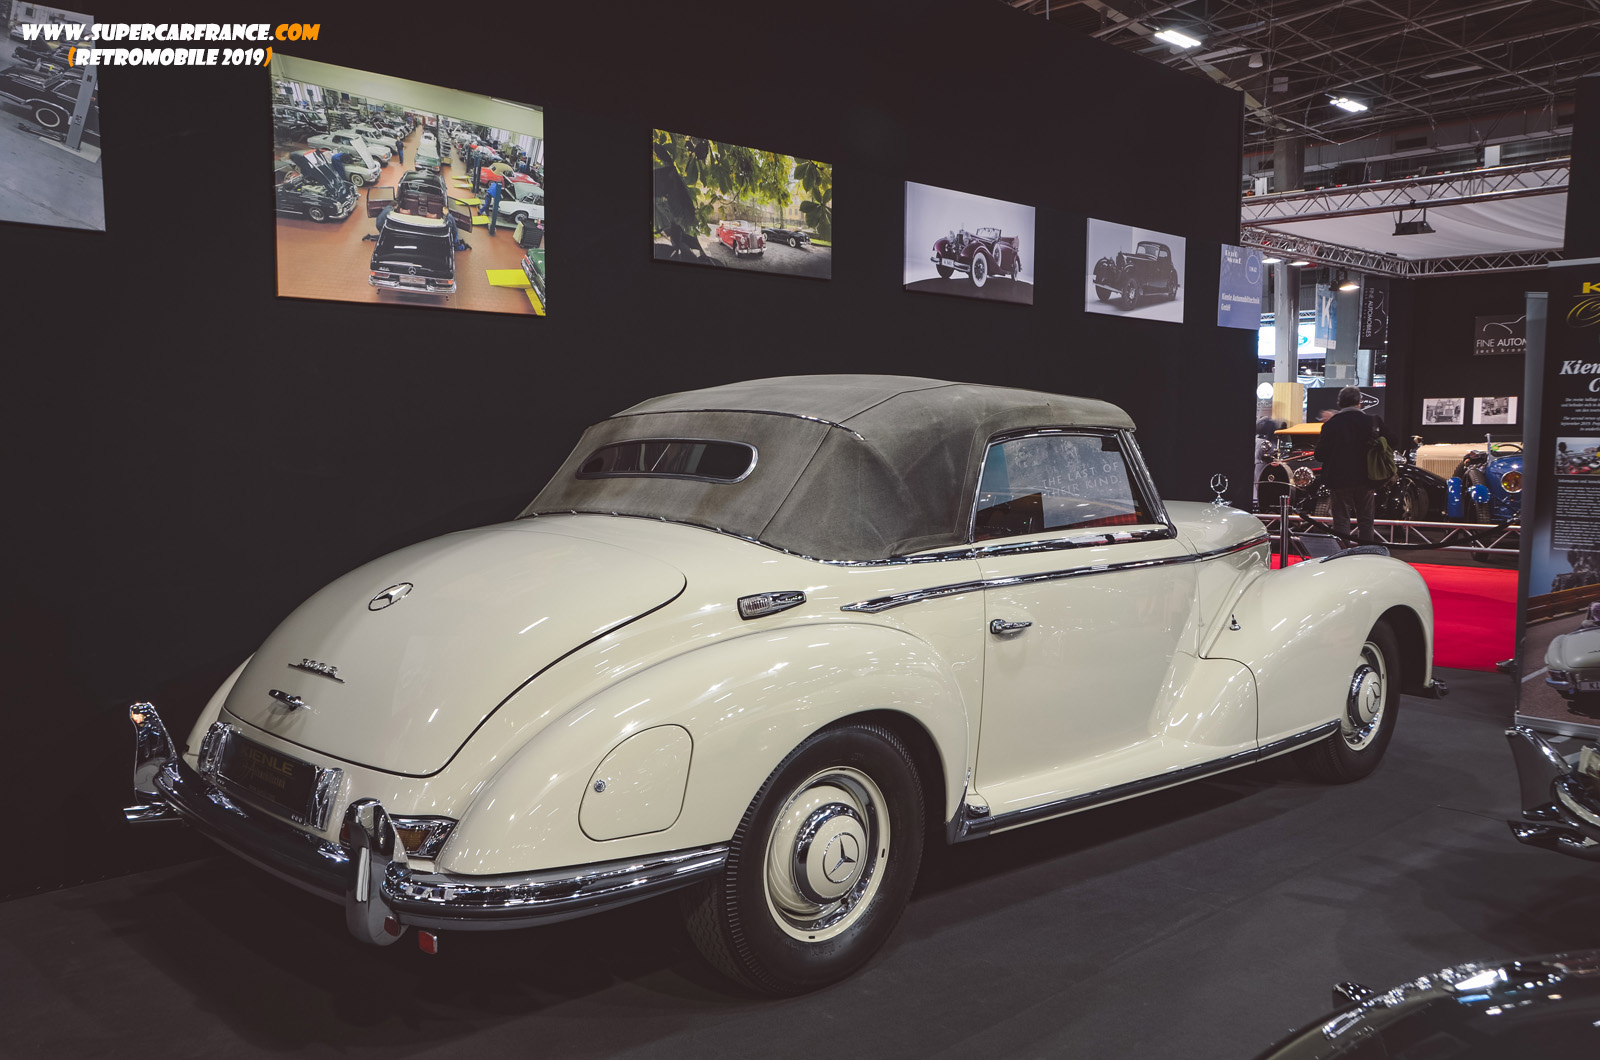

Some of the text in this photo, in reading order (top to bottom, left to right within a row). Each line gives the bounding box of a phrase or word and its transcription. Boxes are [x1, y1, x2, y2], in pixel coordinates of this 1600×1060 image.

[1476, 339, 1495, 348] FINE
[1042, 463, 1119, 489] THE LAST OF
